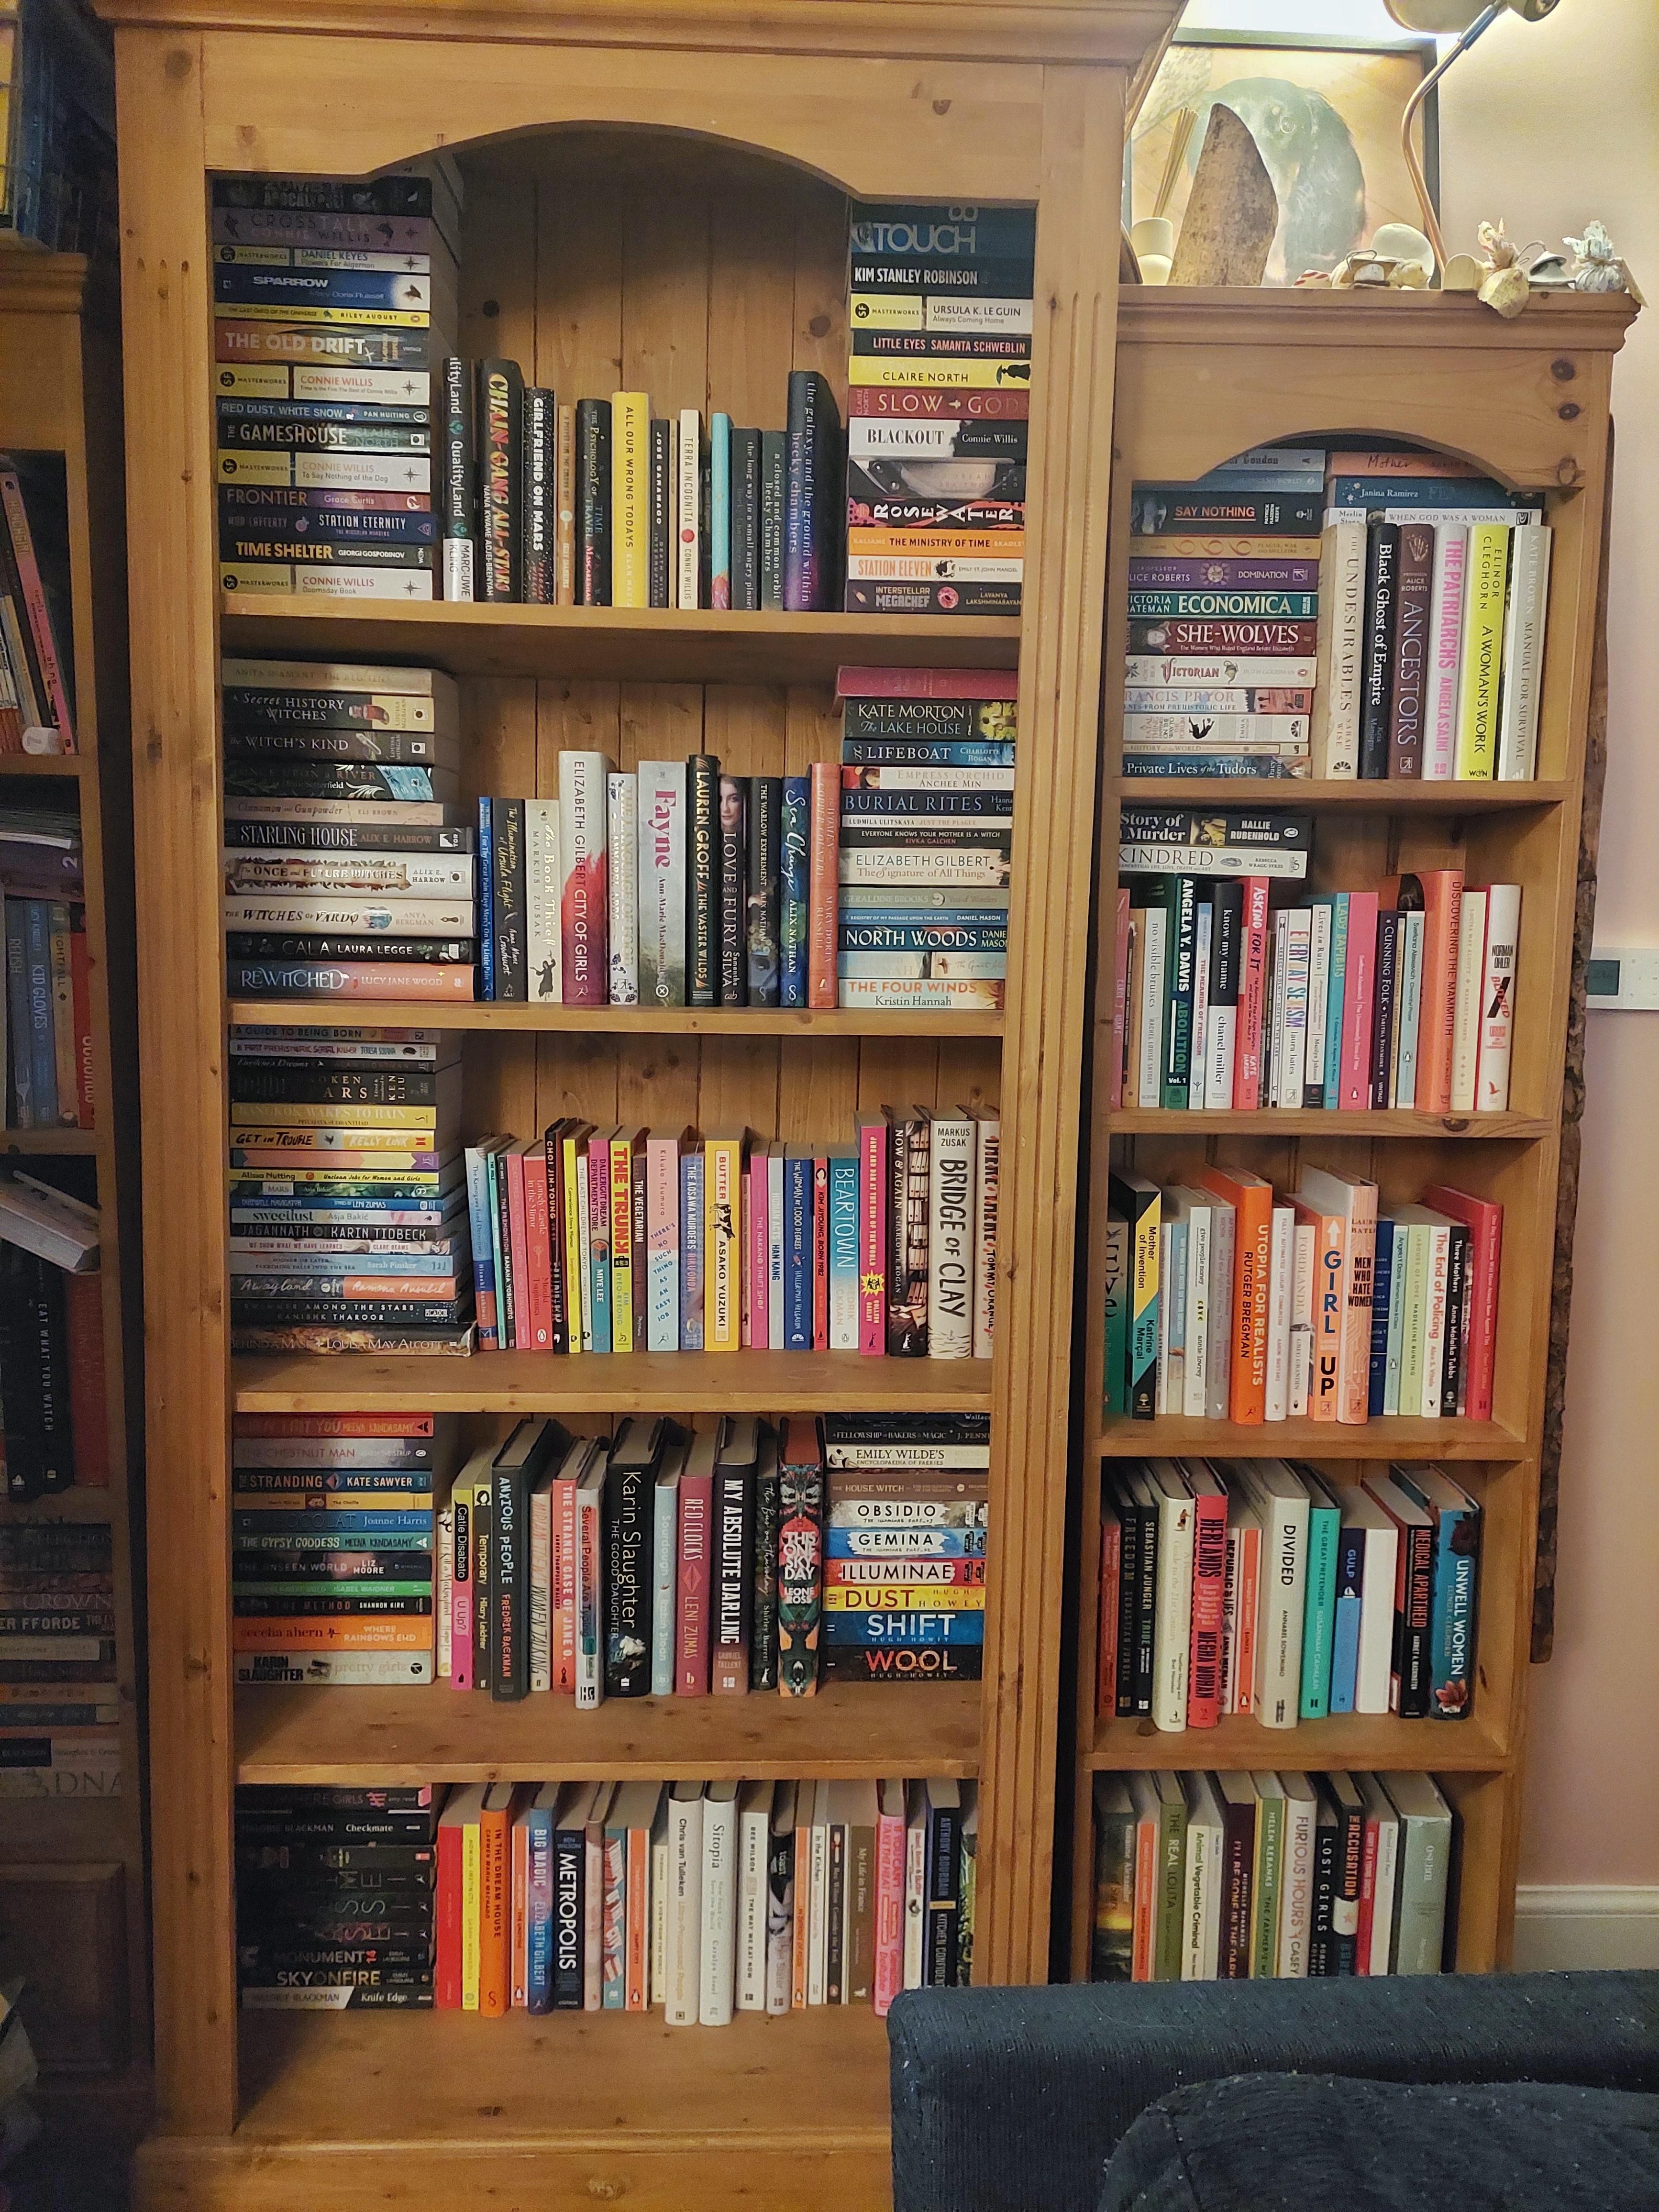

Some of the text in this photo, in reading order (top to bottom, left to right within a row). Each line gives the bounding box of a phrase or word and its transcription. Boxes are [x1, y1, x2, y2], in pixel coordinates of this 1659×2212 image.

[254, 276, 329, 288] SPARROW
[855, 267, 977, 285] KIM STANLEY ROBINSON
[933, 305, 1021, 316] URSULA K. LE GUIN
[873, 337, 1025, 354] LITTLE EYES SAMANTA SCHWEBLIN
[240, 424, 346, 444] GAMESHOUSE
[867, 429, 1018, 444] BLACKOUT Connie Willis
[450, 441, 465, 518] QualityLand
[533, 398, 543, 551] GIRLFRIEND ON MARS
[626, 459, 634, 500] WRONG
[685, 437, 694, 523] TERRA INCOGNITA
[319, 515, 406, 530] STATION ETERNITY
[1175, 507, 1255, 517] SAY NOTHING
[625, 505, 634, 548] TODAYS
[236, 542, 333, 559] TIME SHELTER
[1239, 571, 1288, 579] DOMINATION
[1479, 535, 1503, 610] ELINOR CLEGHORN
[1179, 596, 1292, 614] ECONOMICA
[1177, 625, 1298, 644] SHE-WOLVES
[1369, 543, 1392, 706] Black Ghost of Empire
[1397, 601, 1424, 746] ANCESTORS
[859, 704, 964, 722] KATE MORTON
[867, 746, 951, 760] LIFEBOAT
[845, 796, 982, 811] BURIAL RITES
[648, 790, 676, 868] Fayne
[696, 771, 709, 880] LAUREN GROFF
[1230, 830, 1280, 841] RUBENHOLD
[1241, 820, 1271, 830] HALLIE
[241, 826, 357, 847] STARLING HOUSE
[574, 761, 587, 982] ELIZABETH GILBERT CITY OF GIRLS
[1222, 909, 1233, 938] know
[846, 930, 976, 946] NORTH WOODS
[337, 944, 413, 955] LAURA LEGGE
[1219, 941, 1228, 957] my
[1492, 945, 1513, 956] NORMAN
[1494, 958, 1510, 969] OHLER
[242, 968, 349, 989] REWITCHED
[1175, 878, 1194, 1074] ANGELA Y. DAVIS ABOLITION
[849, 982, 977, 993] THE FOUR WINDS
[875, 995, 951, 1006] Kristin Hannah
[614, 1148, 629, 1254] THE TRUNK
[835, 1168, 856, 1268] BEARTOWN
[331, 1227, 426, 1240] KARIN TIDBECK
[939, 1160, 968, 1318] BRIDGE OF CLAY
[1148, 1227, 1157, 1260] Mother
[772, 1244, 781, 1281] HAN KANG
[1138, 1234, 1147, 1289] of Invention
[1354, 1257, 1371, 1269] MEN
[1354, 1270, 1371, 1282] WHO
[1353, 1283, 1371, 1294] HATE
[1241, 1251, 1253, 1358] RUTGER BREGMAN
[1252, 1225, 1269, 1385] UTOPIA FOR REALISTS
[1320, 1250, 1342, 1396] GIRL UP
[1137, 1327, 1145, 1360] Marçal
[1146, 1320, 1154, 1353] Katrine
[856, 1449, 945, 1459] EMILY WILDE'S
[250, 1475, 412, 1488] STRANDING KATE SAWYER
[858, 1505, 935, 1516] OBSIDIO
[499, 1477, 513, 1583] ANXIOUS PEOPLE
[785, 1531, 816, 1544] THIS
[859, 1534, 933, 1545] GEMINA
[618, 1471, 641, 1628] Karin Slaughter
[784, 1544, 815, 1557] ONE
[1198, 1518, 1224, 1578] HERLANDS
[1281, 1525, 1296, 1586] DIVIDED
[720, 1479, 743, 1644] MY ABSOLUTE DARLING
[785, 1556, 812, 1570] SKY
[1347, 1549, 1356, 1578] GULP
[784, 1567, 815, 1580] DAY
[842, 1565, 951, 1580] ILLUMINAE
[1412, 1529, 1431, 1627] MEDICAL APARTHEID
[845, 1590, 915, 1607] DUST
[867, 1614, 955, 1636] SHIFT
[1450, 1560, 1469, 1675] UNWELL WOMEN
[866, 1651, 957, 1671] WOOL
[346, 1824, 393, 1832] Checkmate
[679, 1818, 687, 1841] Chris
[709, 1824, 725, 1869] Sitopia
[534, 1829, 547, 1887] BIG MAGIC
[1291, 1816, 1309, 1927] FURIOUS HOURS
[1317, 1838, 1332, 1932] LOST GIRLS
[559, 1853, 577, 1970] METROPOLIS
